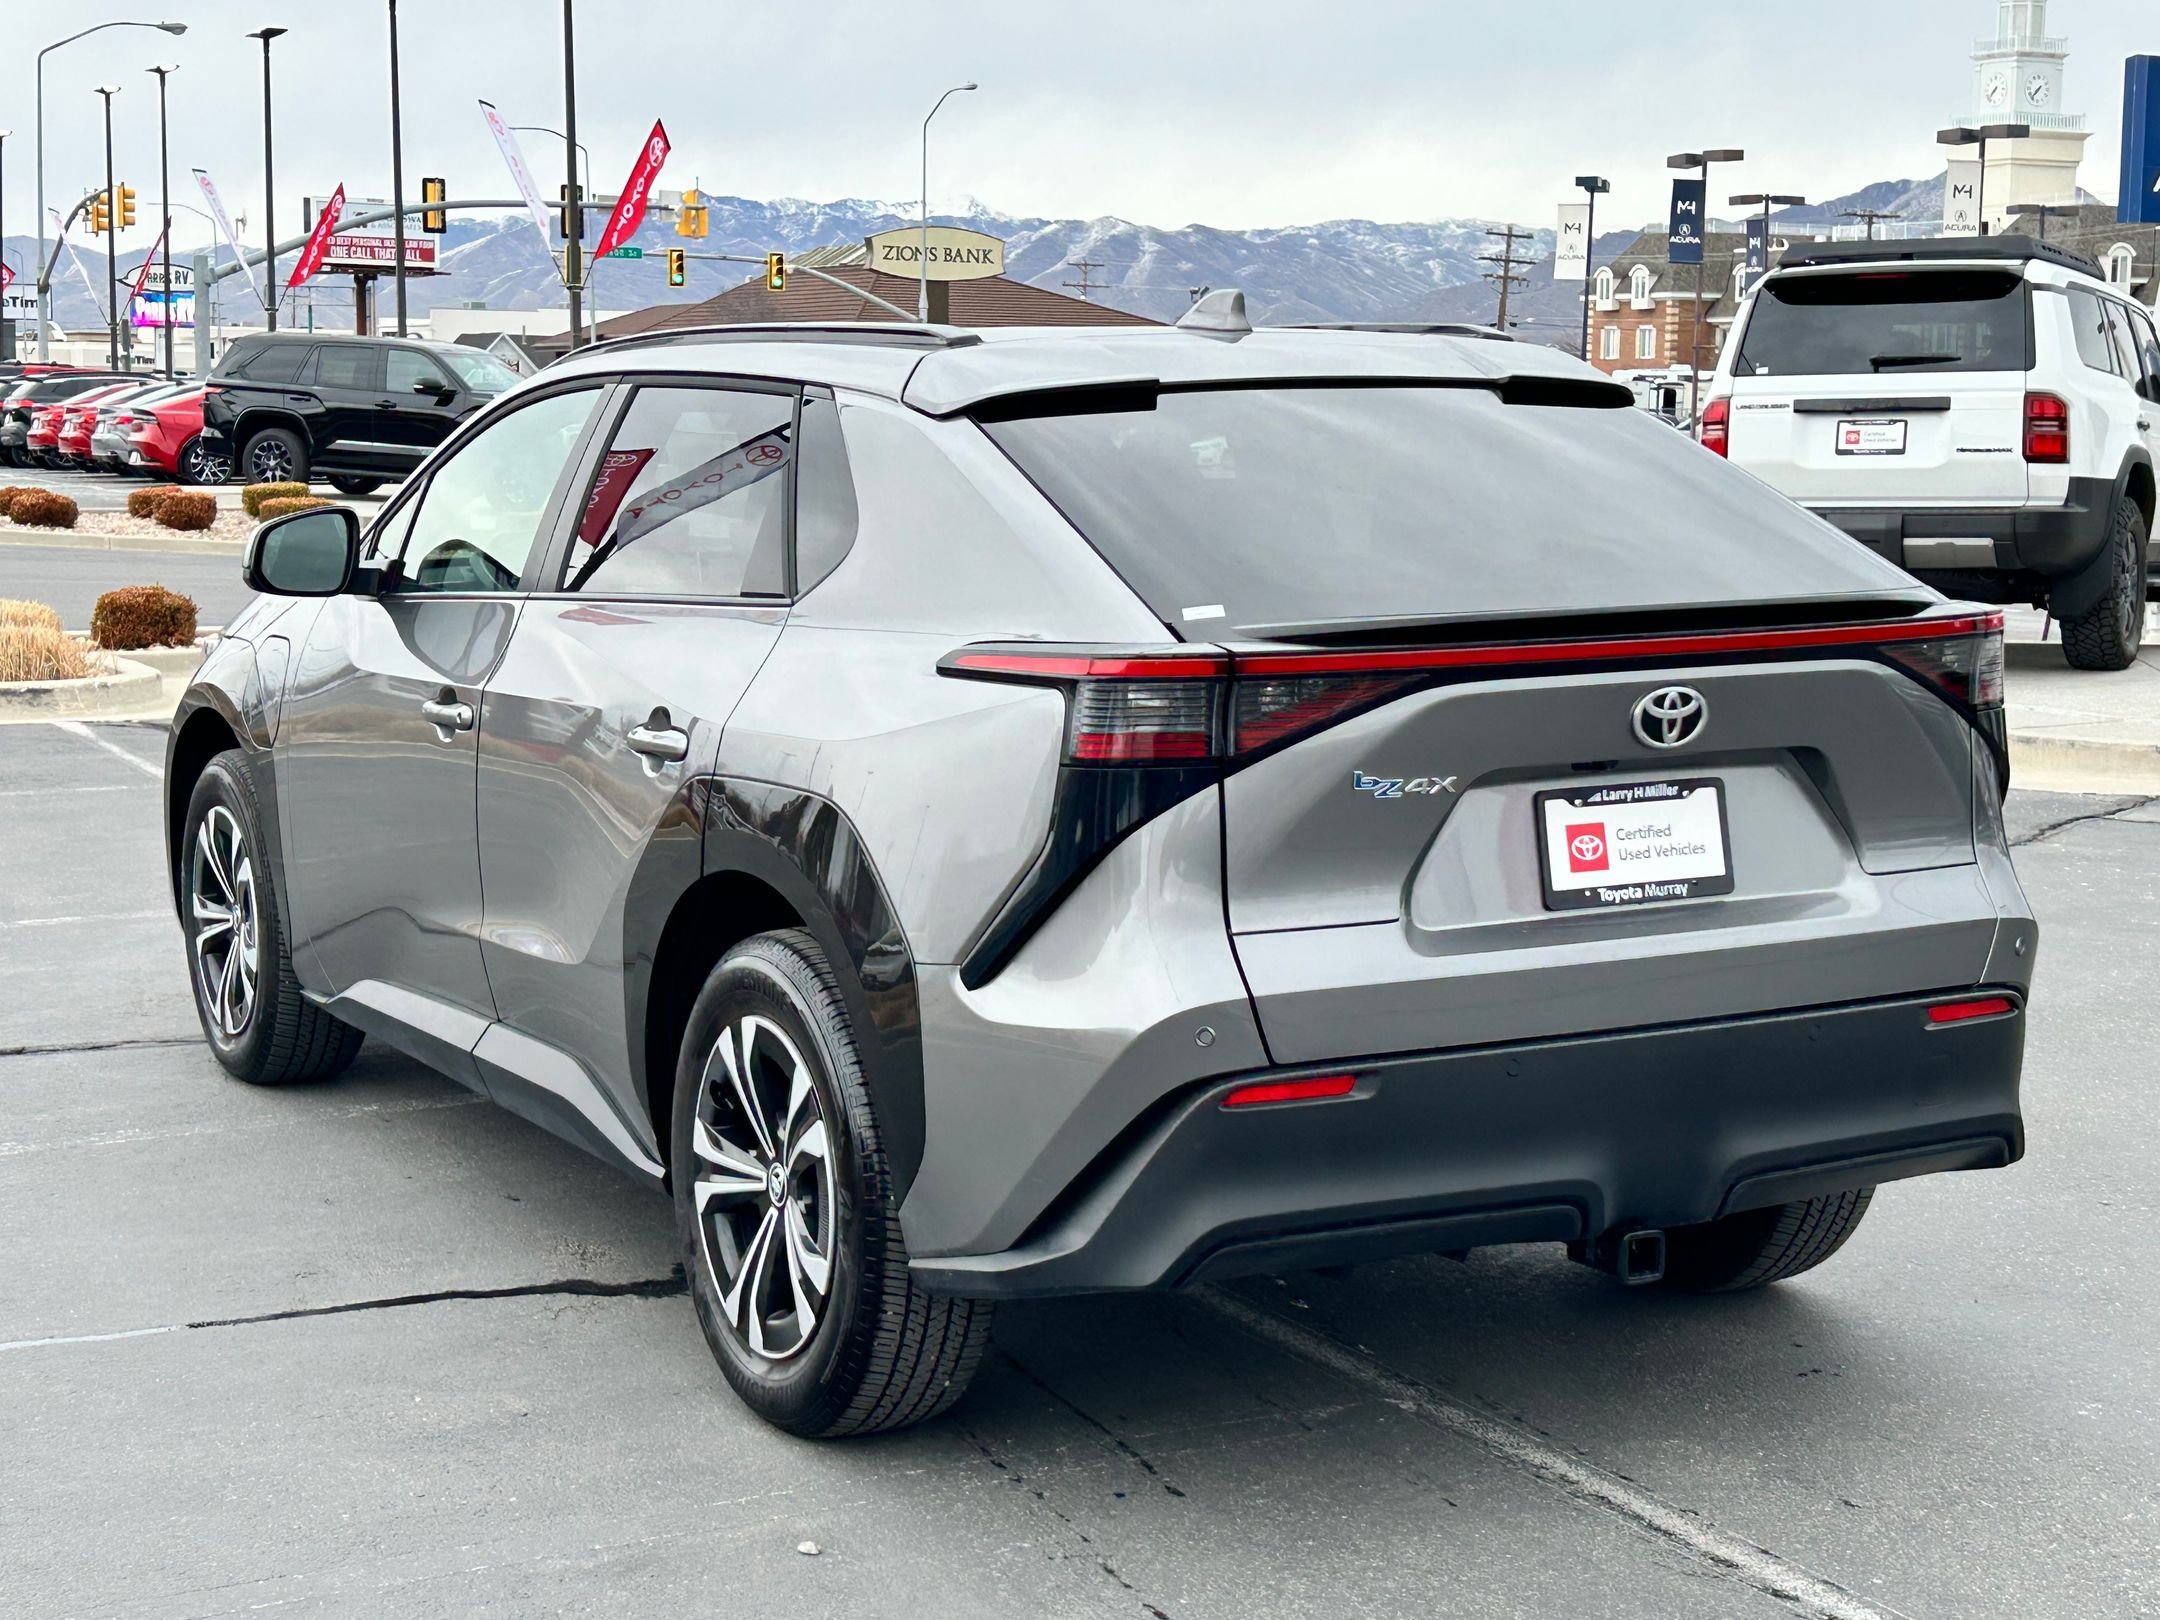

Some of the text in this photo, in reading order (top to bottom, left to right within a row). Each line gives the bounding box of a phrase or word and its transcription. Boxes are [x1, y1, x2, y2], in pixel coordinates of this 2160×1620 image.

[1944, 223, 1977, 232] ACURA
[330, 246, 349, 258] ONE
[350, 247, 373, 259] CALL
[405, 250, 422, 261] ALL
[882, 245, 995, 264] ZIONS BANK
[175, 271, 189, 285] RV
[626, 462, 745, 520] TOYOTA
[1602, 783, 1679, 801] Larry H Miller
[1616, 824, 1672, 841] Certified
[1619, 842, 1706, 861] Used Vehicles
[1597, 883, 1689, 904] Toyota Murray
